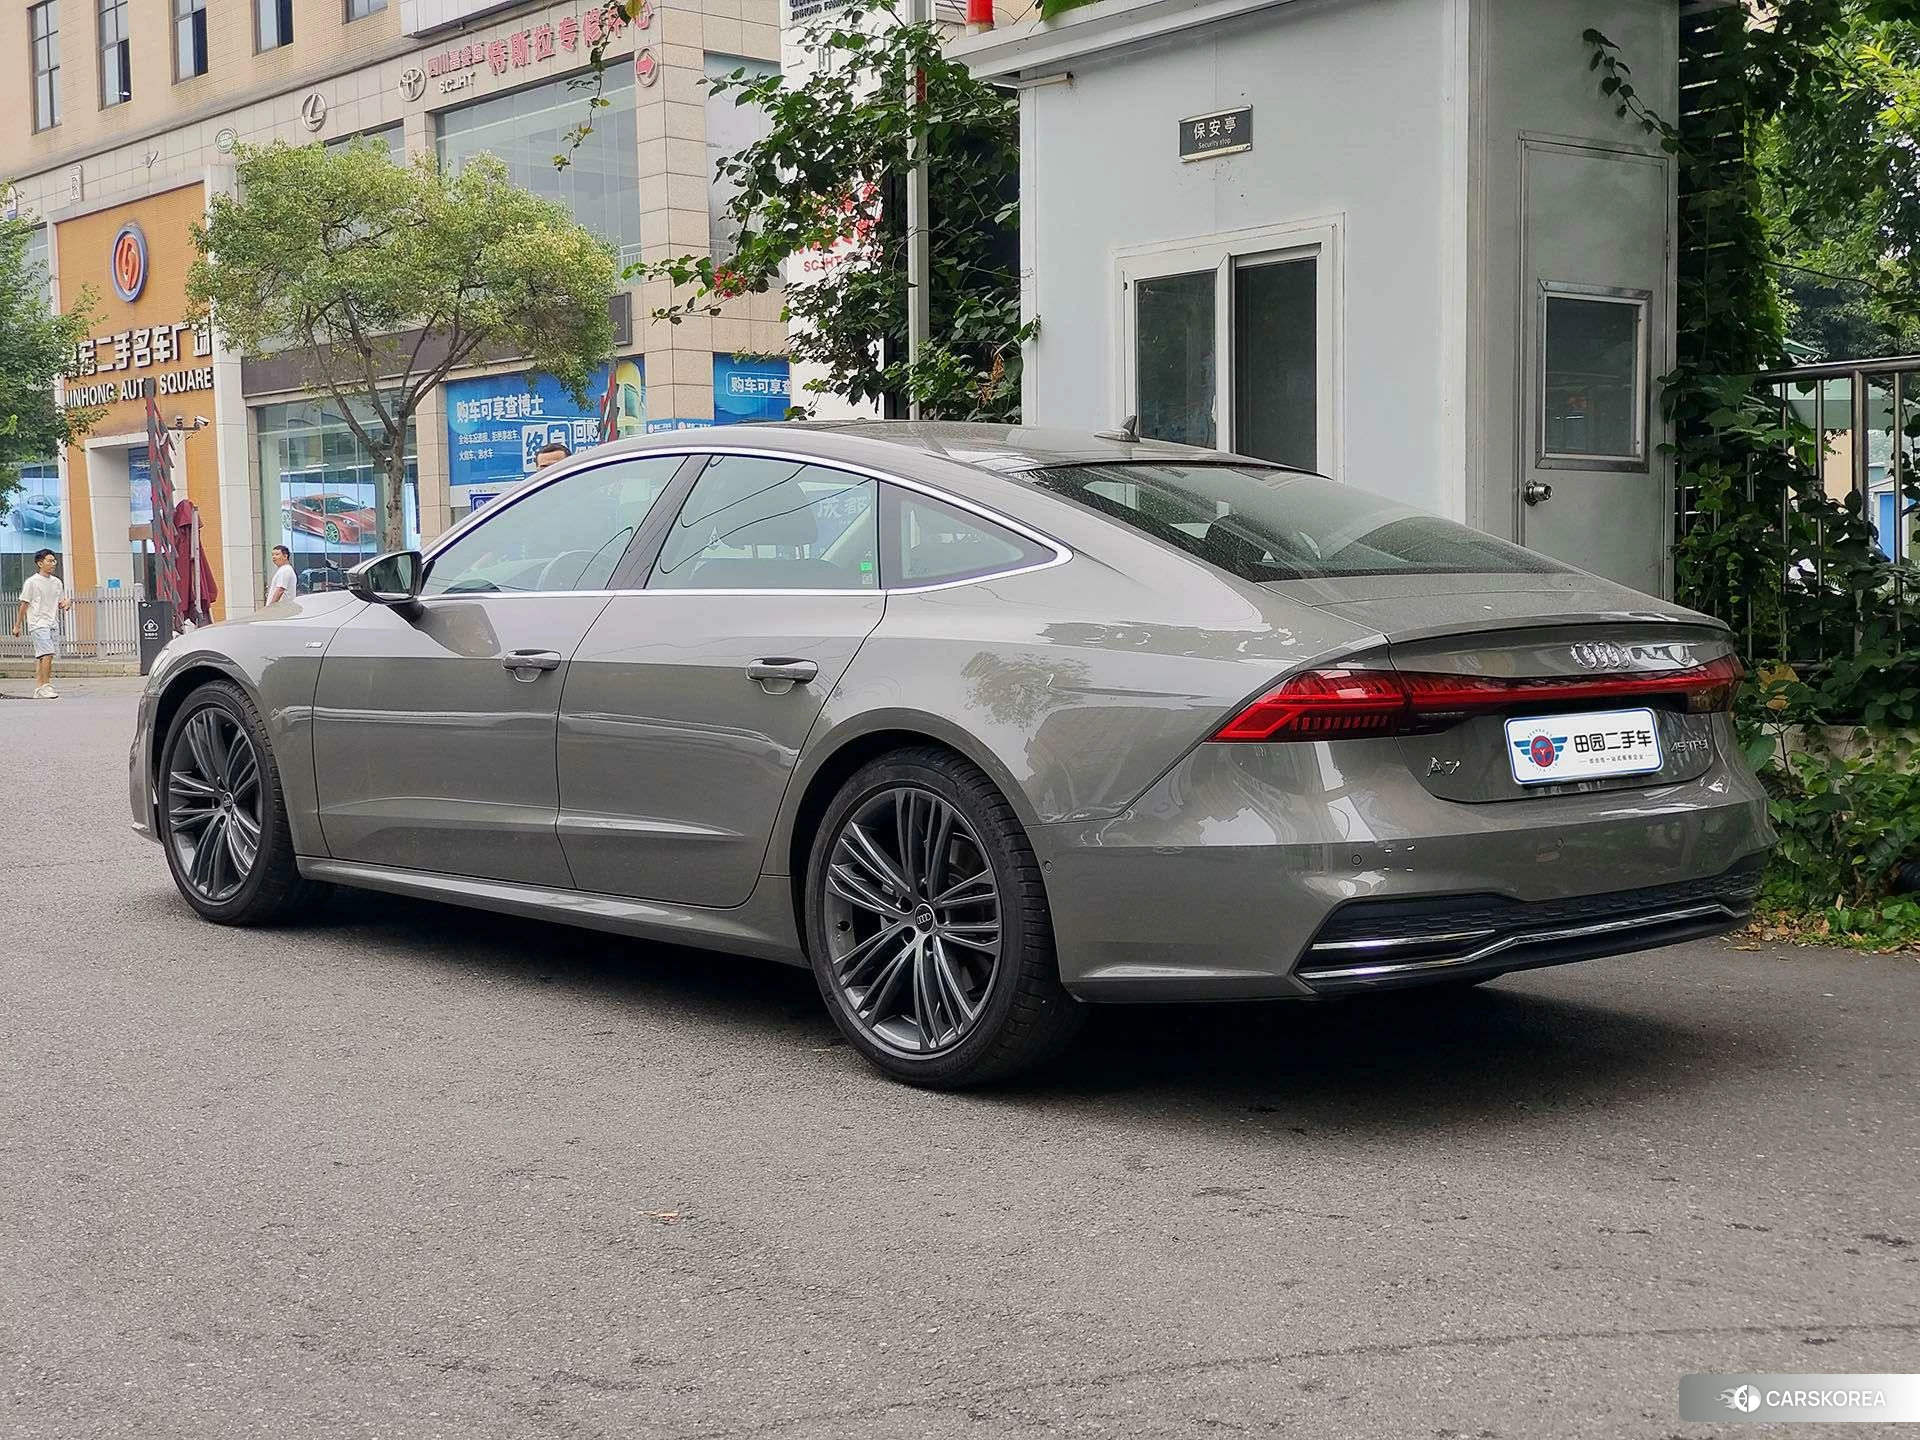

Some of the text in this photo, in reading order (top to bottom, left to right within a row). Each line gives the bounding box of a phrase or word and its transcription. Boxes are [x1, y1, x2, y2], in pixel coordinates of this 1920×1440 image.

[1194, 116, 1237, 141] 保安亭
[804, 256, 842, 272] SCHT
[66, 320, 212, 377] 宏二手名车广场
[120, 377, 145, 401] AUT
[159, 367, 213, 395] SQUARE
[456, 394, 544, 424] 购车可享查博士
[1574, 730, 1652, 753] 田园二手车
[1427, 756, 1461, 777] A7
